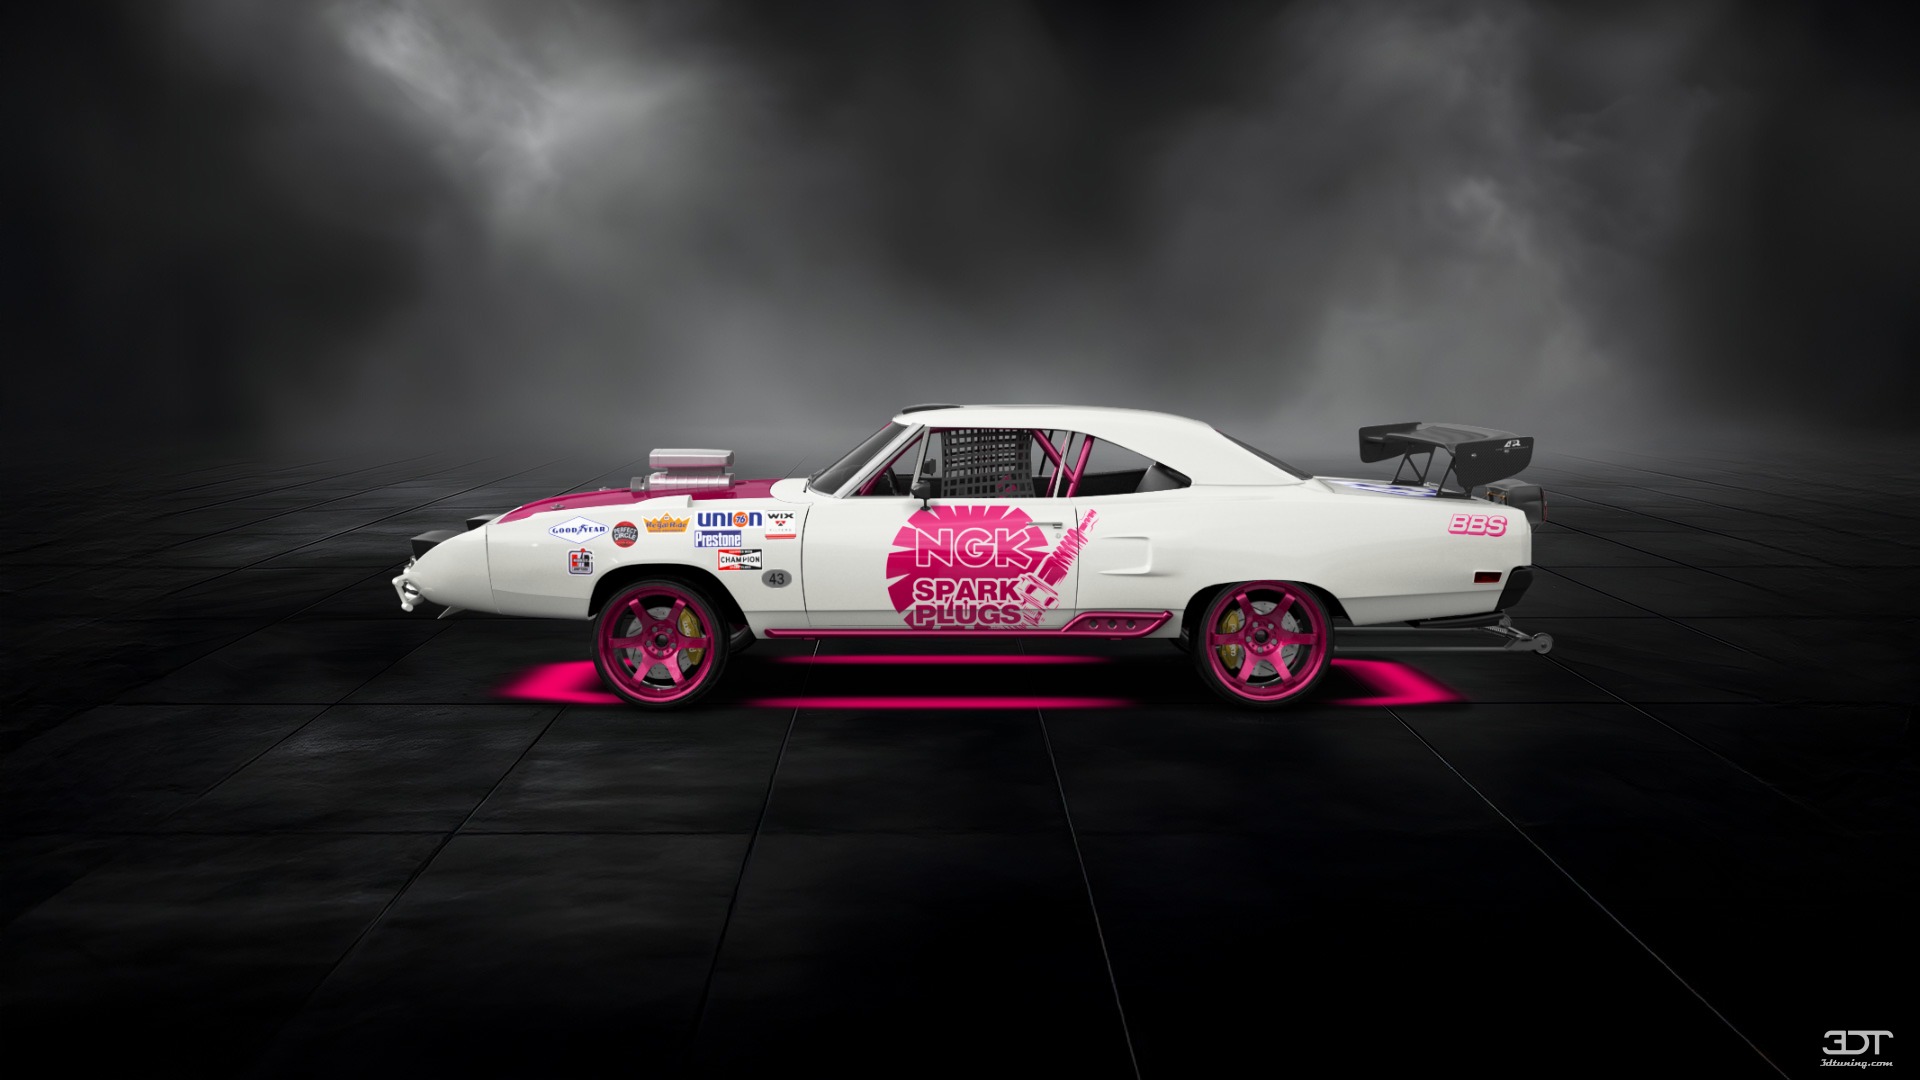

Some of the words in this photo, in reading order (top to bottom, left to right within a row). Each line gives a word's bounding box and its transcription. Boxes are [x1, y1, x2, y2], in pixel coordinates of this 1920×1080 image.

[736, 515, 746, 524] 76
[1448, 513, 1507, 537] BBS
[613, 527, 637, 535] PERFECT
[614, 533, 637, 541] CIRCLE
[695, 531, 741, 547] Prestone
[915, 528, 1033, 569] NGK
[769, 573, 785, 585] 43
[913, 578, 1024, 603] SPARK
[914, 604, 1022, 626] PLUGS
